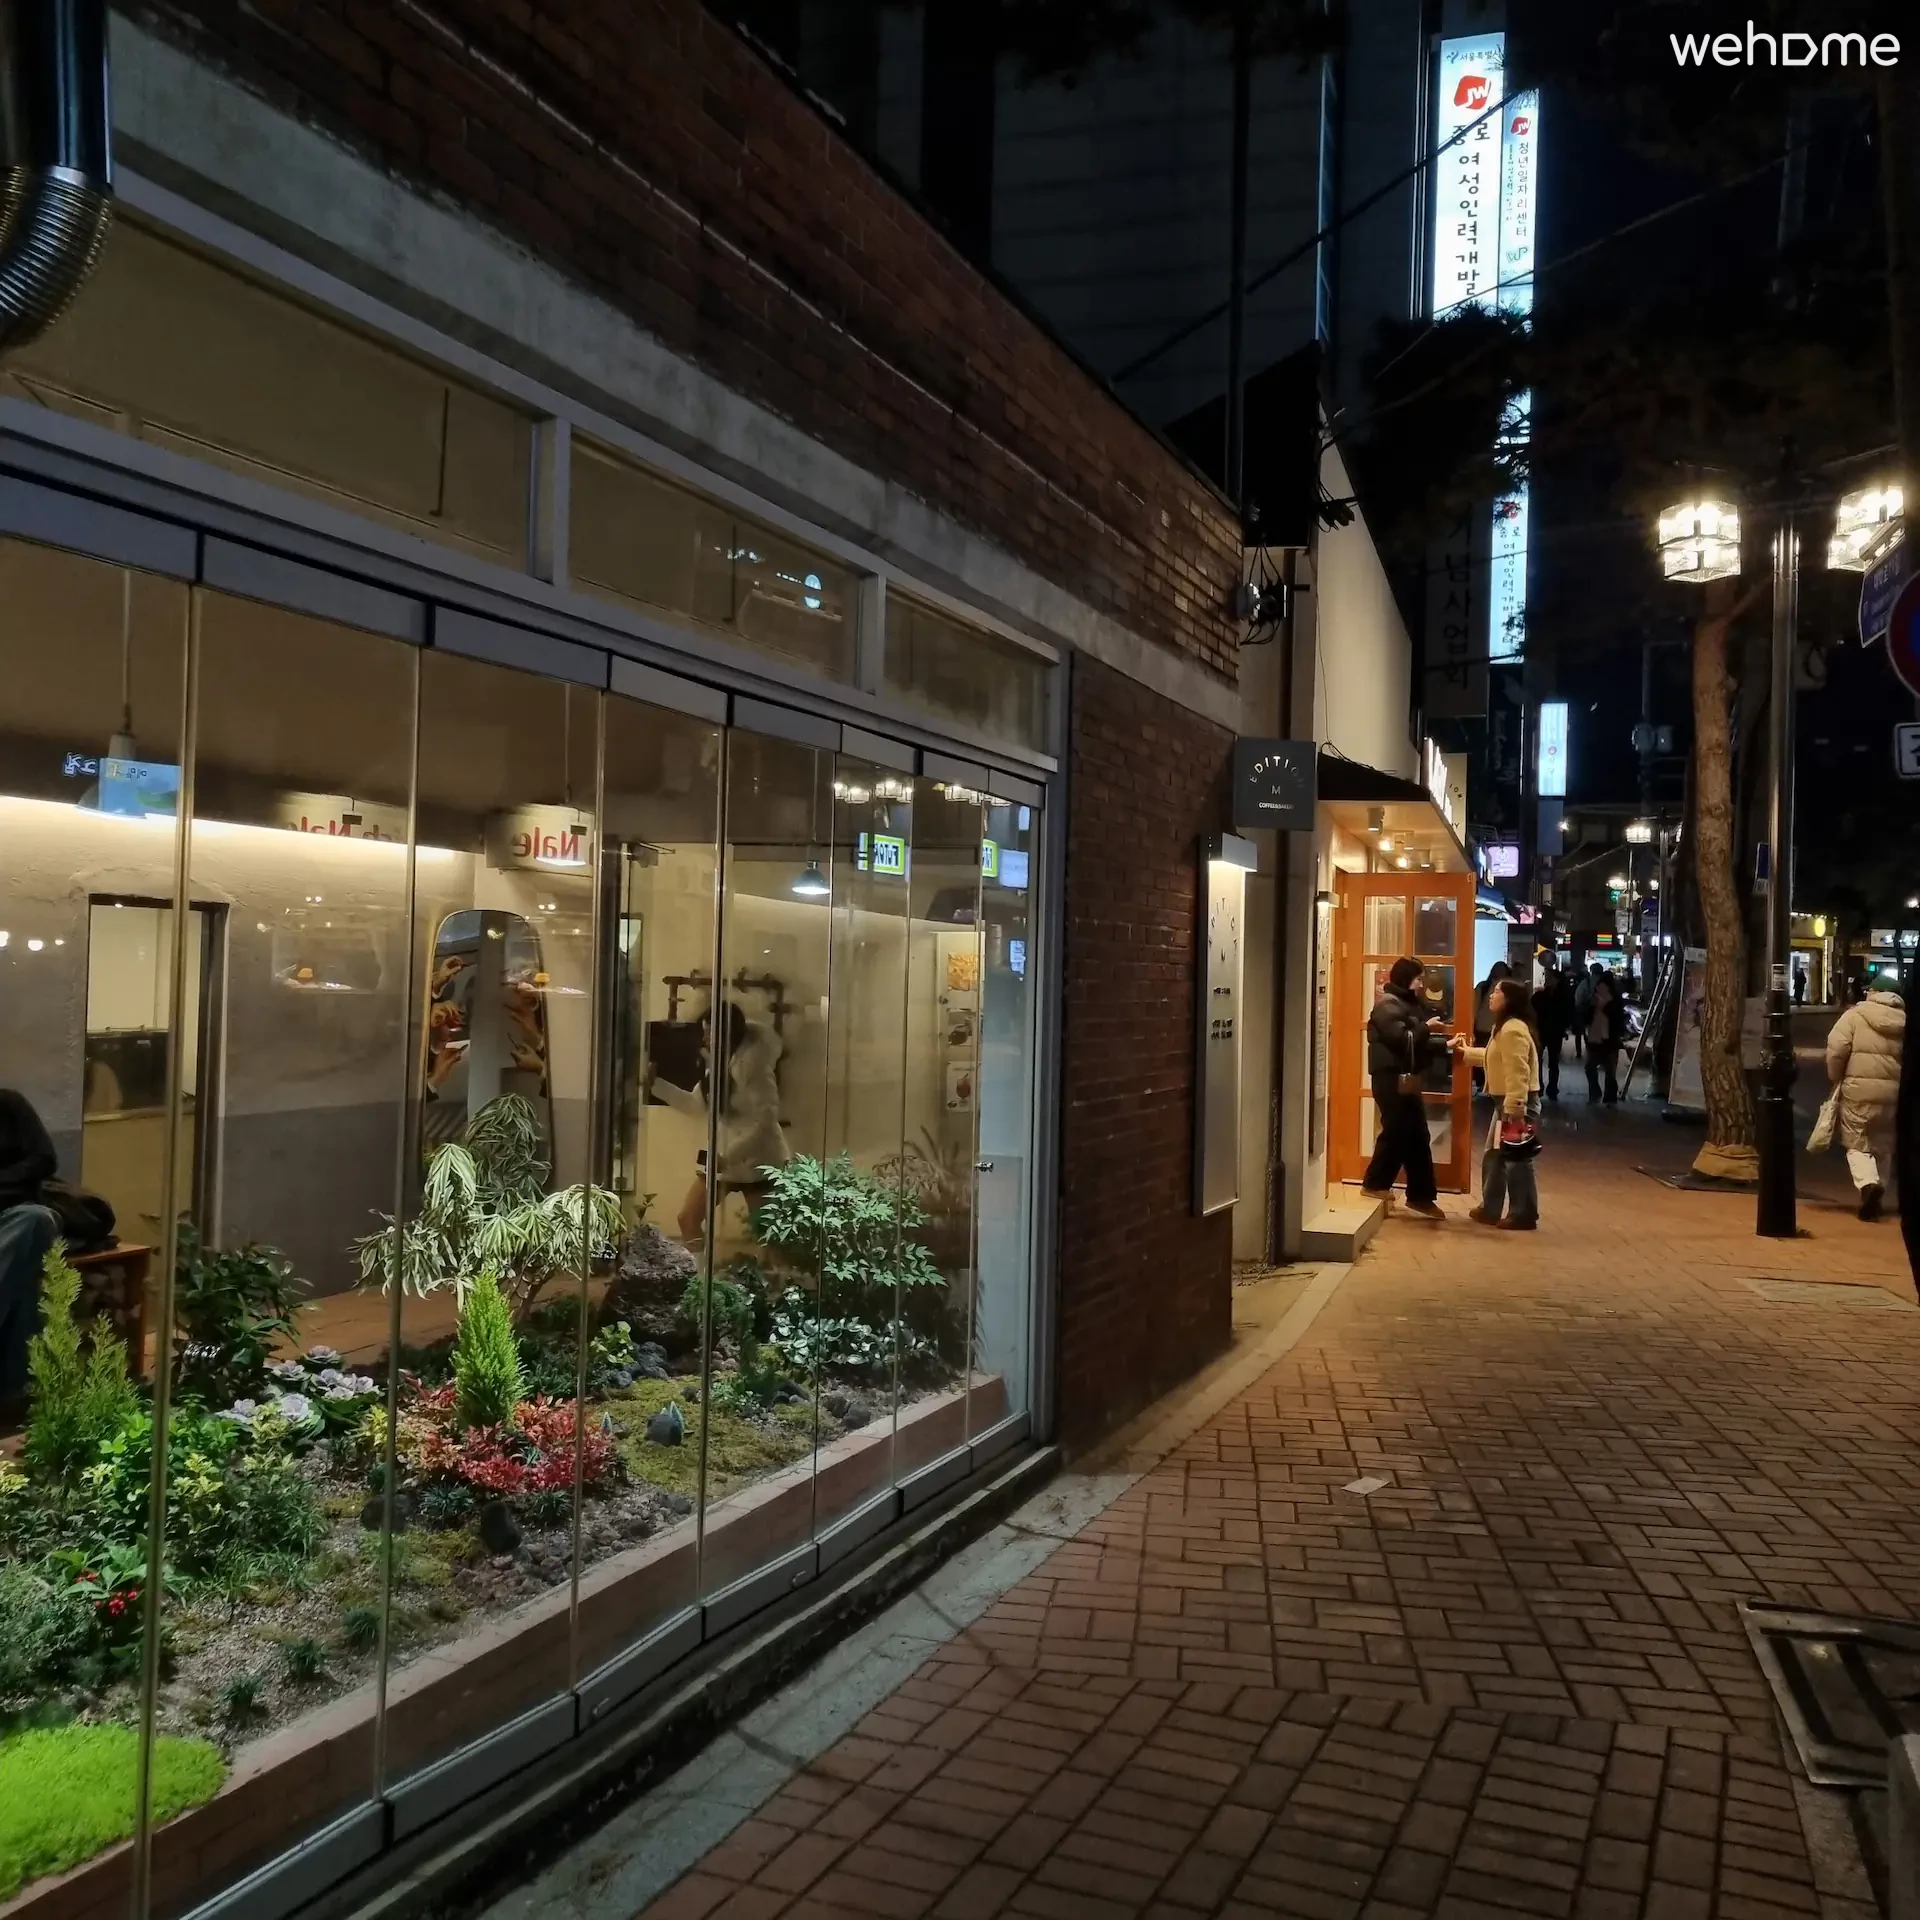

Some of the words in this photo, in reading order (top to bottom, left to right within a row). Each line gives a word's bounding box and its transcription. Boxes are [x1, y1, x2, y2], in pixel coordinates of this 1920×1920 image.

[1516, 142, 1529, 236] 청년일자리센터
[1499, 526, 1521, 538] 종로
[1271, 785, 1281, 795] M
